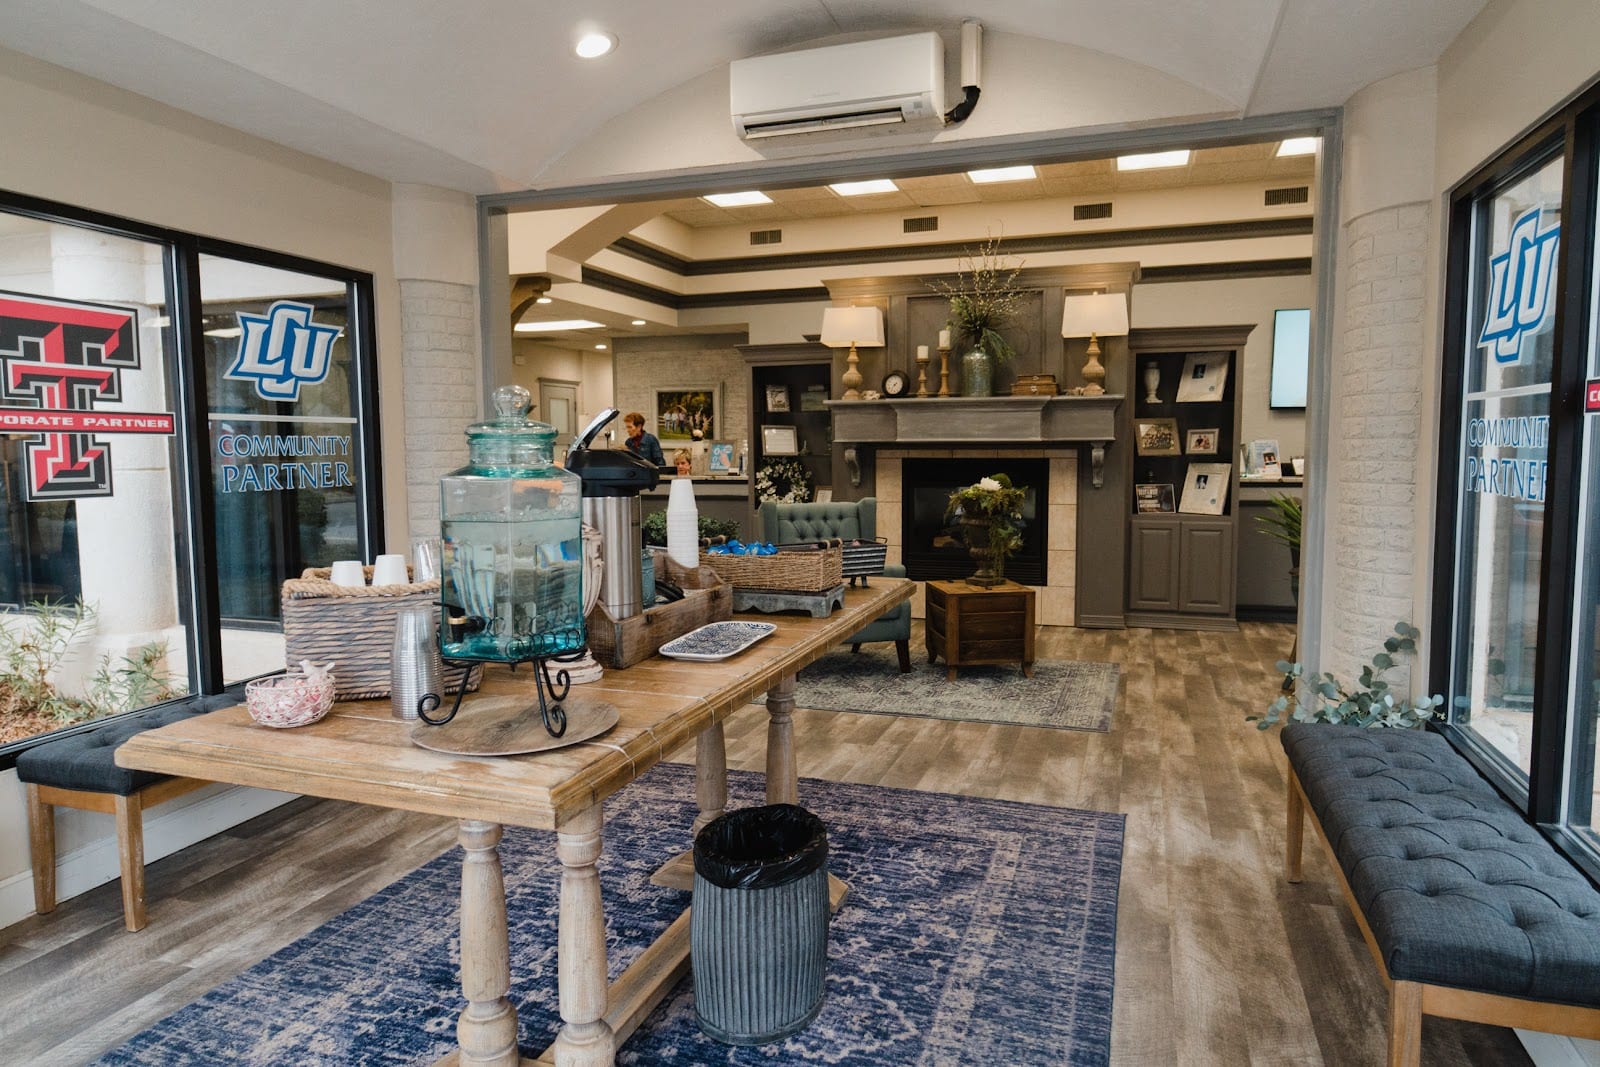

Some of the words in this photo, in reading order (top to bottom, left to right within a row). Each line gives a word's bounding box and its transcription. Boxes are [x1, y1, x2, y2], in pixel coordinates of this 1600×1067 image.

[223, 300, 345, 402] LCU
[0, 415, 74, 426] ORATE
[83, 417, 169, 428] PARTNER
[1468, 415, 1550, 448] COMMUNIT
[218, 434, 350, 457] COMMUNITY
[221, 462, 352, 493] PARTNER
